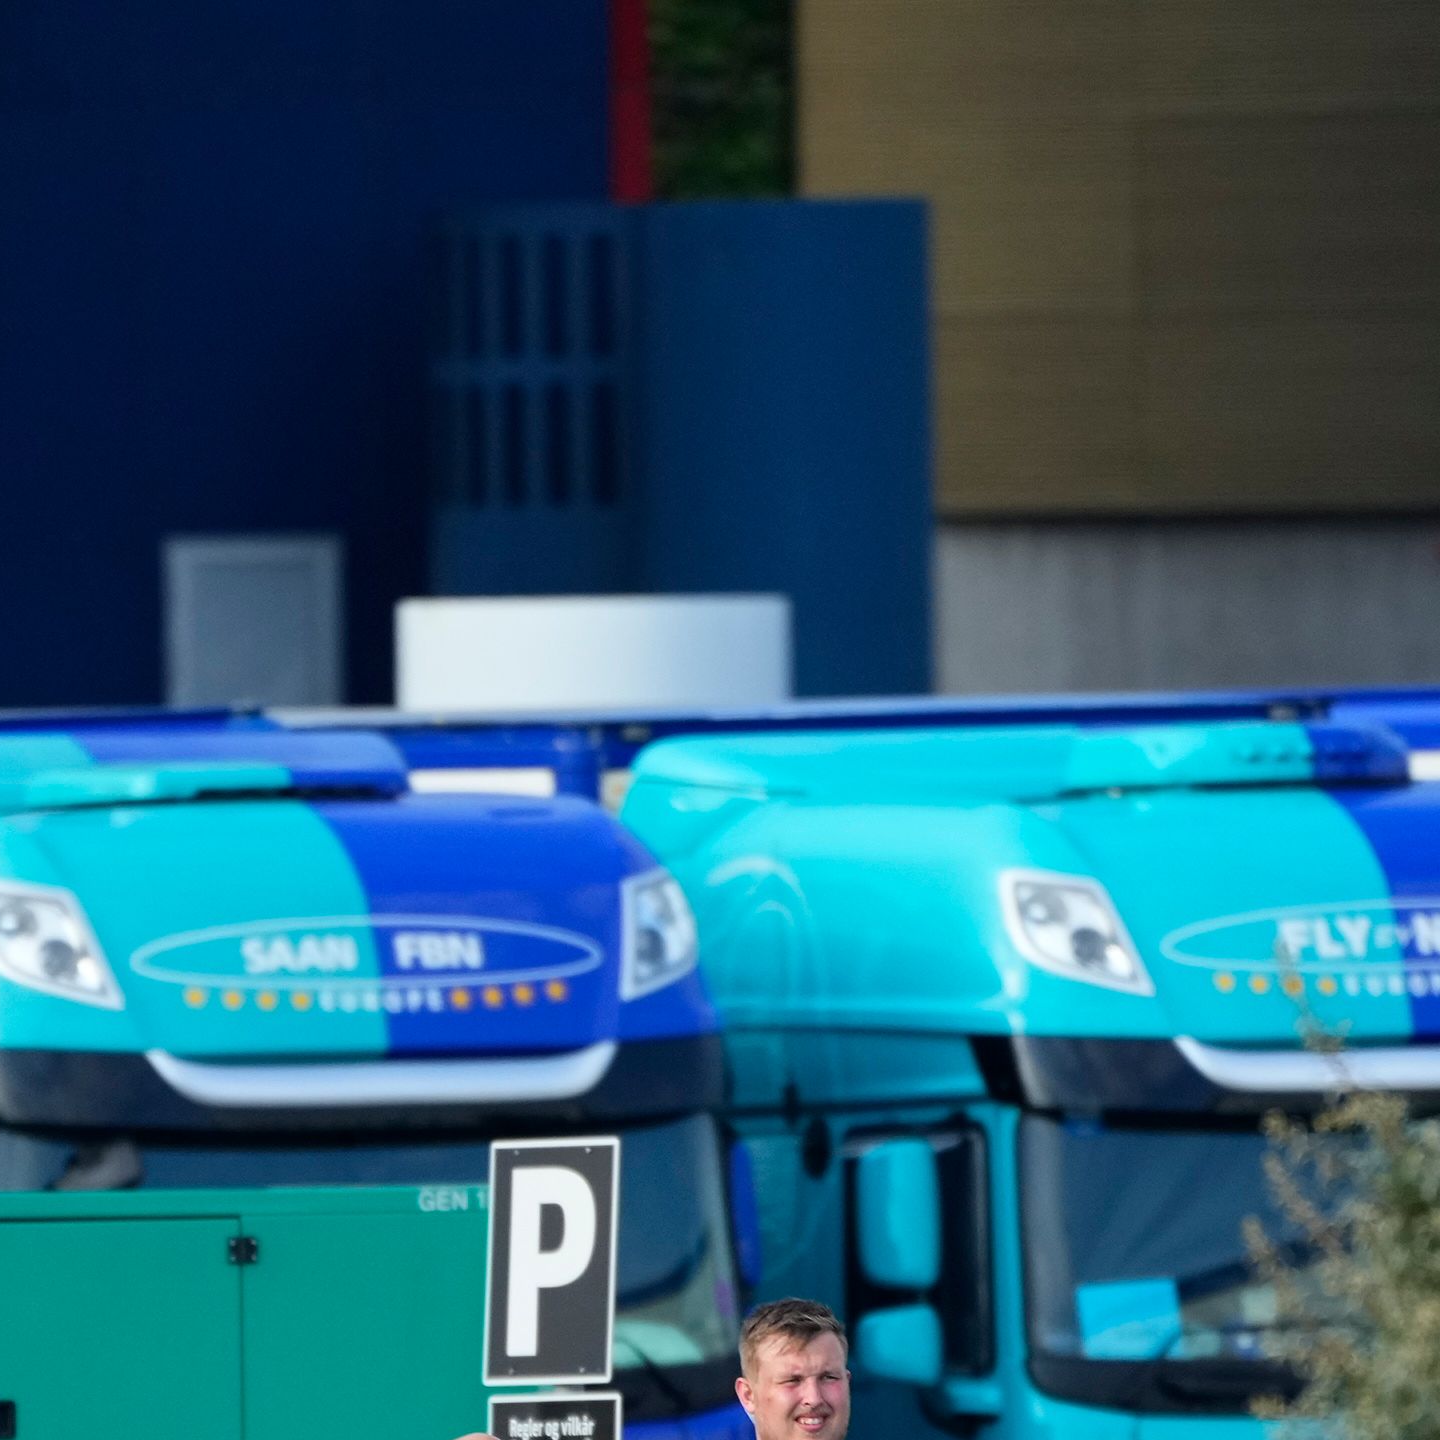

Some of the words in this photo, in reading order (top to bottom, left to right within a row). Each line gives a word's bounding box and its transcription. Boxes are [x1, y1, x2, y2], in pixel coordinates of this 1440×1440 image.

[1277, 914, 1372, 960] FLY
[506, 1166, 597, 1358] P
[508, 1417, 543, 1440] Regler
[544, 1420, 560, 1440] og
[560, 1414, 595, 1436] vilkår
